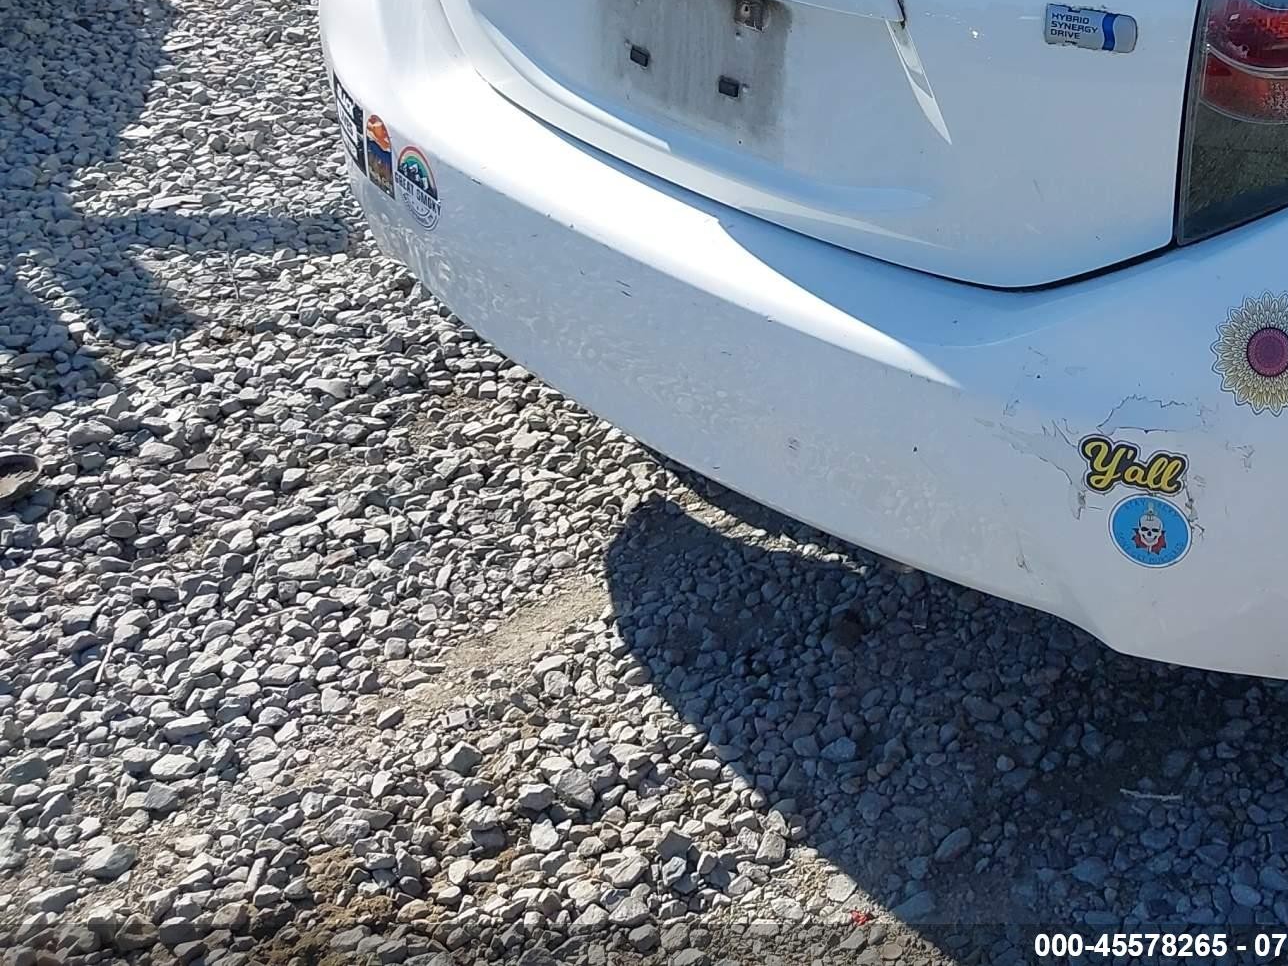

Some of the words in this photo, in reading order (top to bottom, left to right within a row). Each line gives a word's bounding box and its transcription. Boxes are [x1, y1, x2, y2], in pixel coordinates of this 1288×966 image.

[1051, 13, 1090, 24] HYBRID
[1051, 20, 1098, 33] SYNERGY
[1050, 28, 1081, 39] DRIVE
[394, 171, 414, 195] GREAT
[416, 188, 441, 216] SMOKY
[1084, 440, 1183, 492] Y'all
